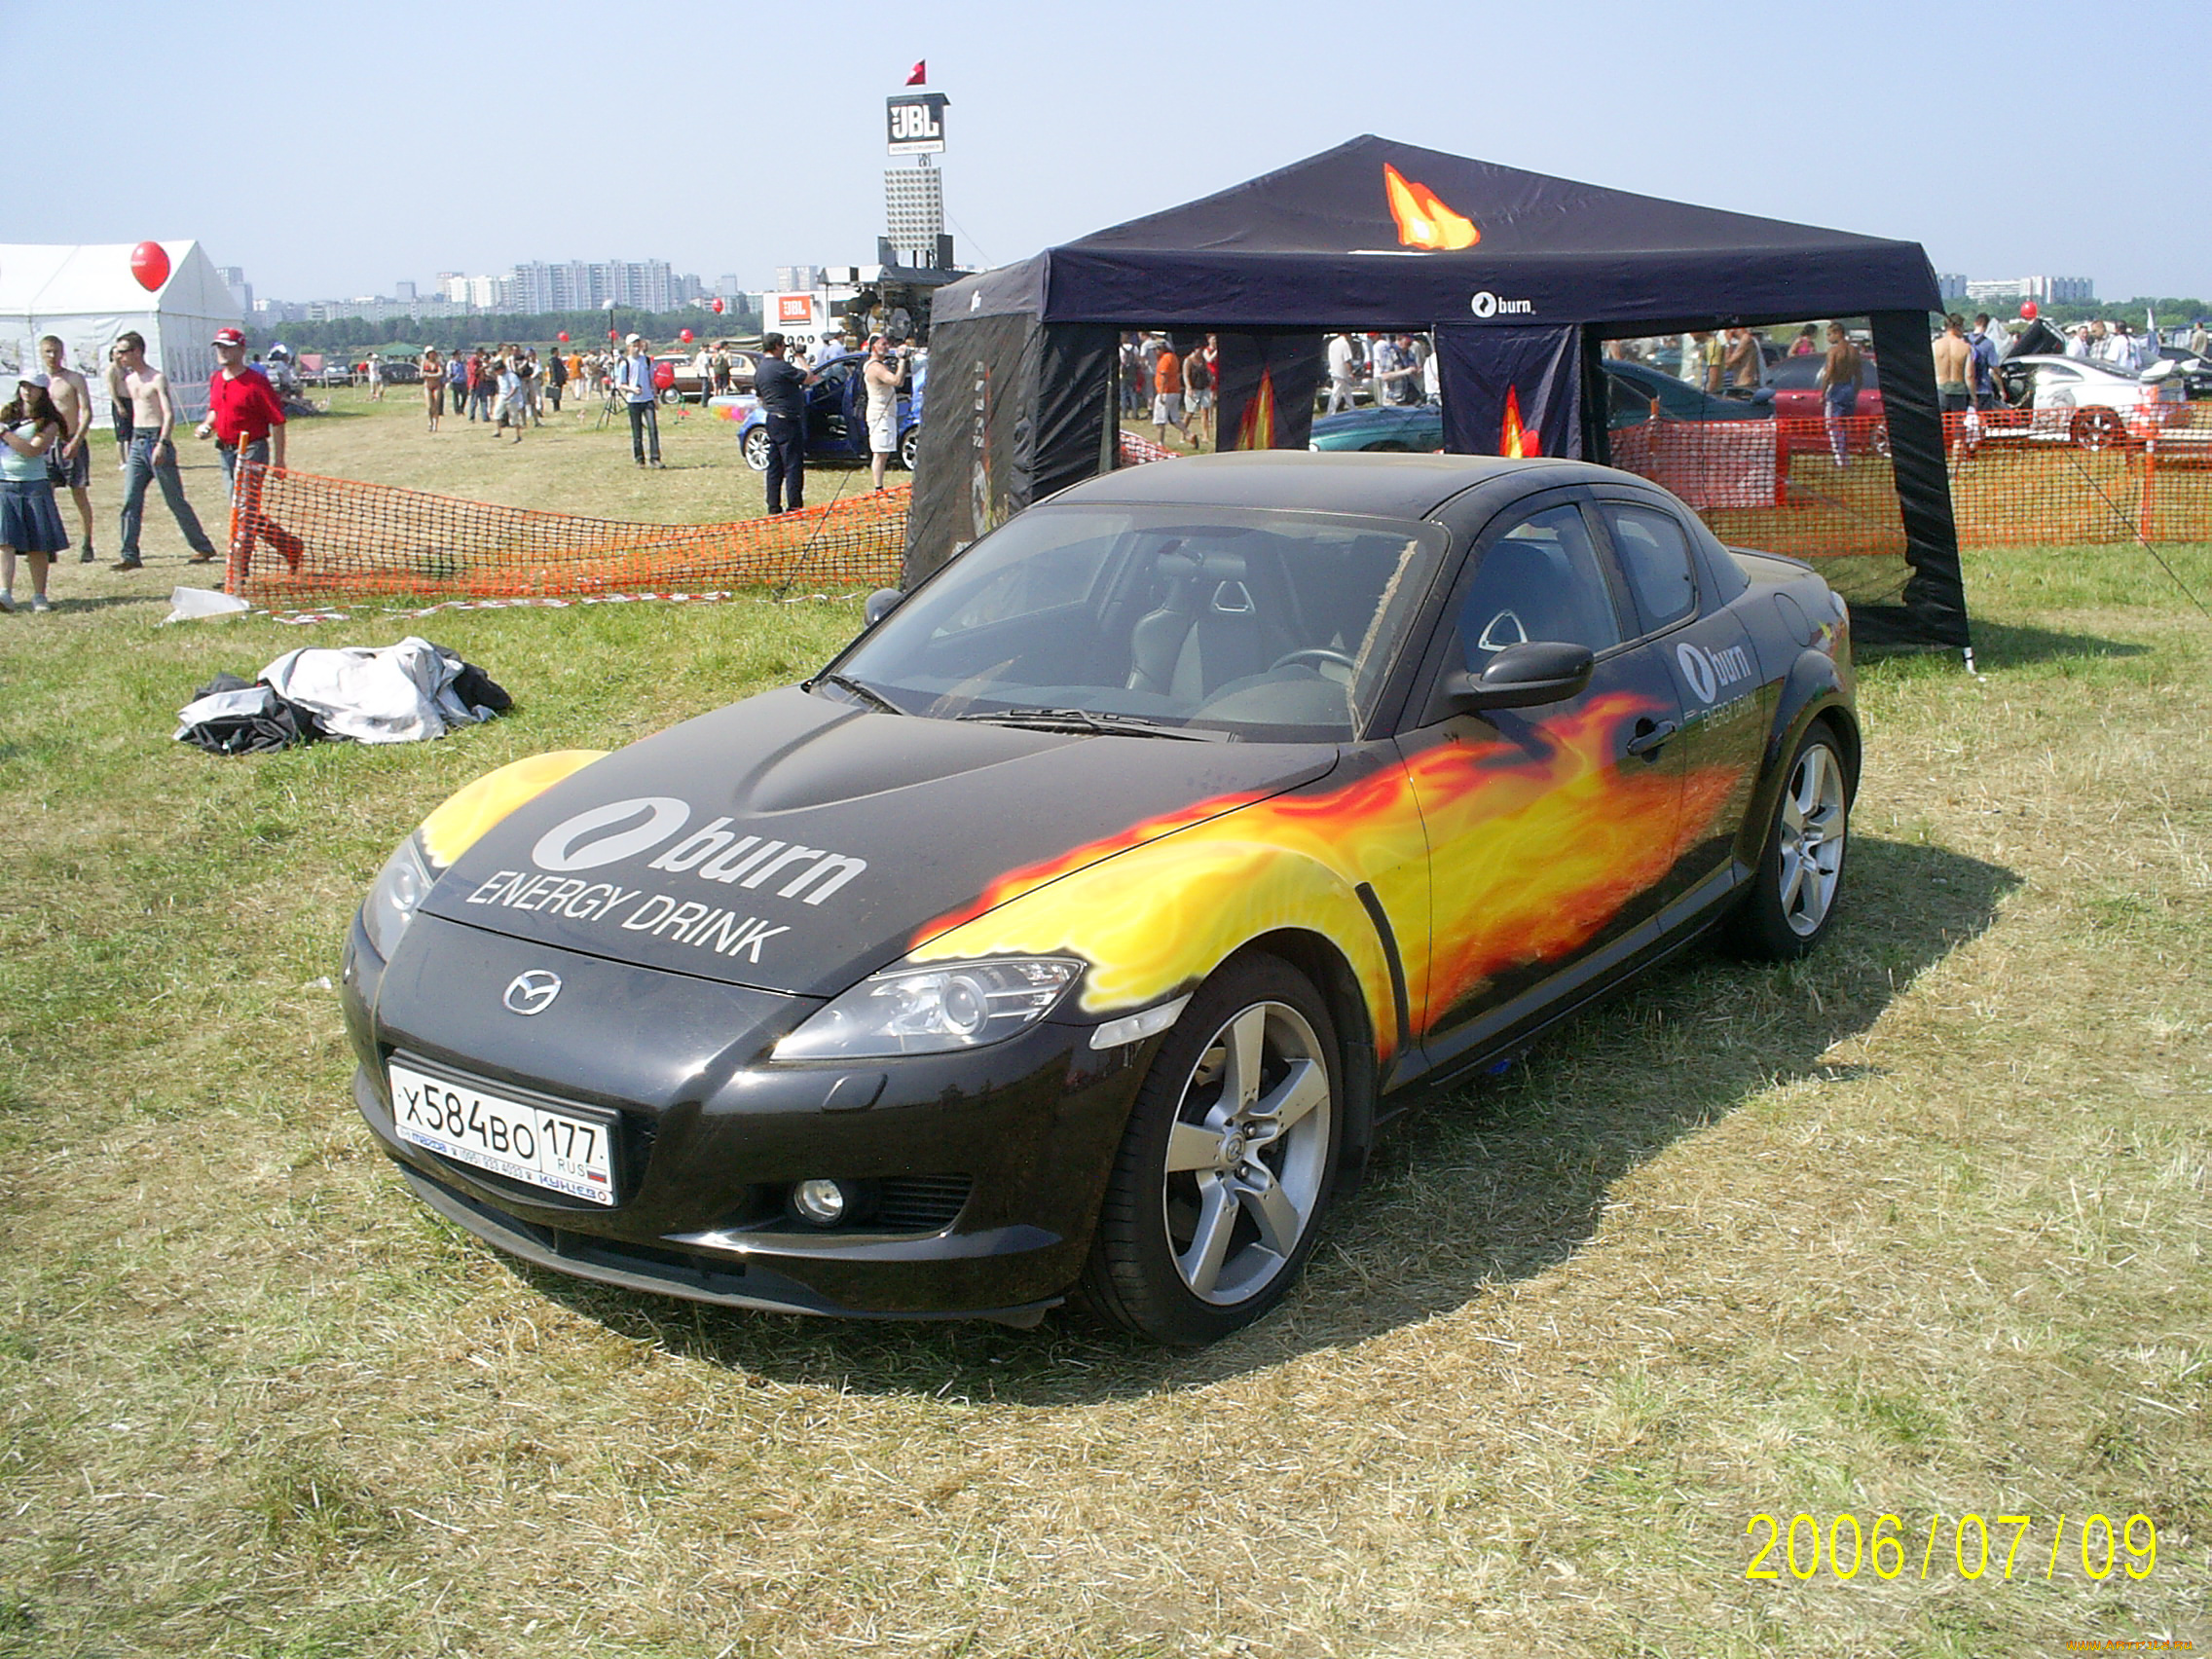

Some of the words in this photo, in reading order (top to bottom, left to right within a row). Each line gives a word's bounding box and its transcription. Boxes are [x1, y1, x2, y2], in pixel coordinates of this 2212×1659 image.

[890, 104, 940, 138] JBL
[783, 300, 806, 315] JBL
[1498, 297, 1531, 313] burn
[1704, 645, 1751, 687] burn
[648, 817, 868, 906] burn
[466, 870, 641, 922] ENERGY
[621, 894, 791, 964] DRINK
[543, 1119, 595, 1163] 177
[558, 1158, 585, 1177] RUS
